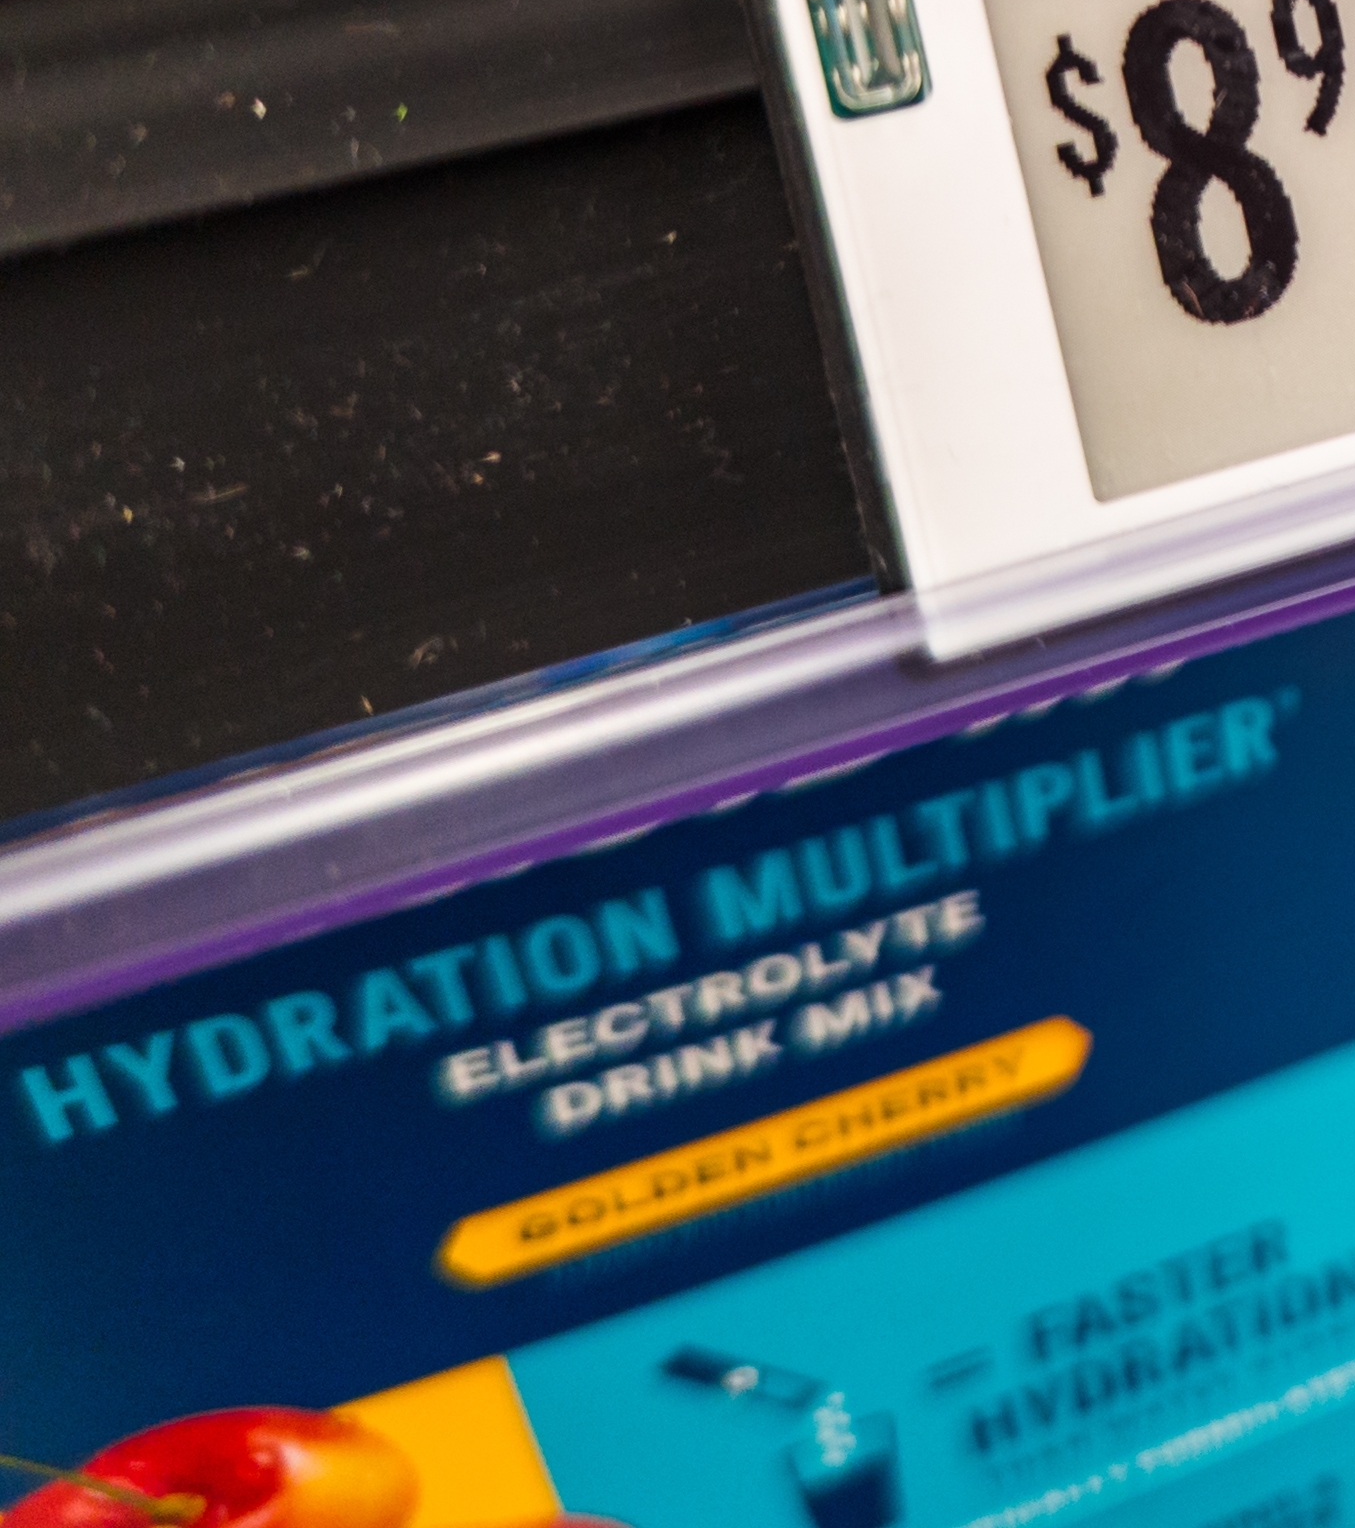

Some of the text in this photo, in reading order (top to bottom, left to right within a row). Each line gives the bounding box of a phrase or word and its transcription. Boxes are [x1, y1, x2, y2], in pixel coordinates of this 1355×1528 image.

[20, 690, 1282, 1145] HYDRATION MULTIPLIER
[440, 888, 986, 1099] ELECTROLYTE
[517, 1047, 1030, 1245] GOLDEN CHERRY
[541, 965, 943, 1135] DRINK MIX
[1025, 1217, 1288, 1362] FASTER
